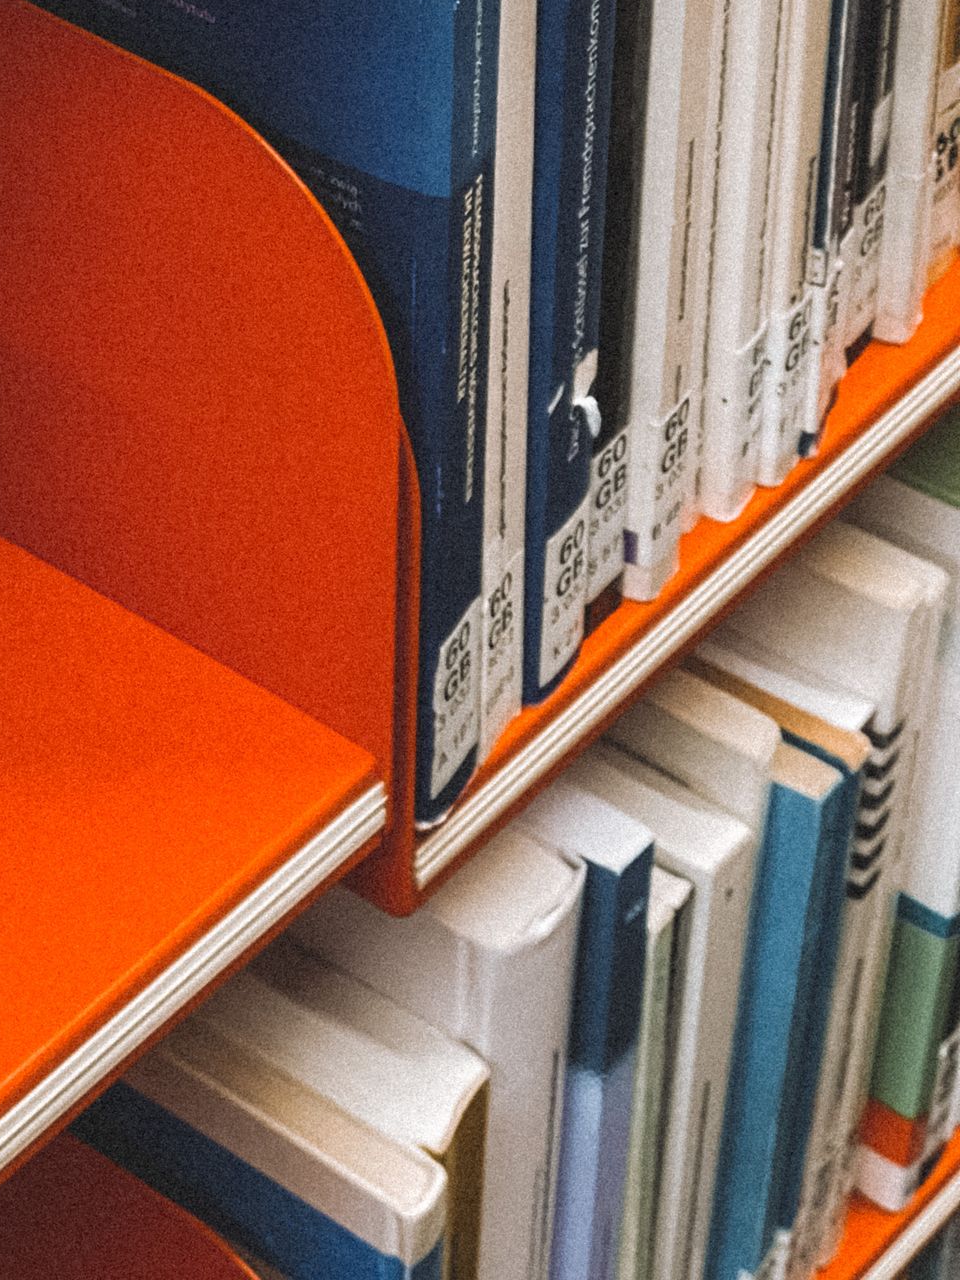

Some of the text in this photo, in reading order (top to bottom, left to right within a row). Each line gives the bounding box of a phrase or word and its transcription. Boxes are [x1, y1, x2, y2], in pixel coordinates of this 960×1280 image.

[598, 434, 626, 479] 60
[560, 520, 585, 565] 60
[445, 621, 470, 671] 60
